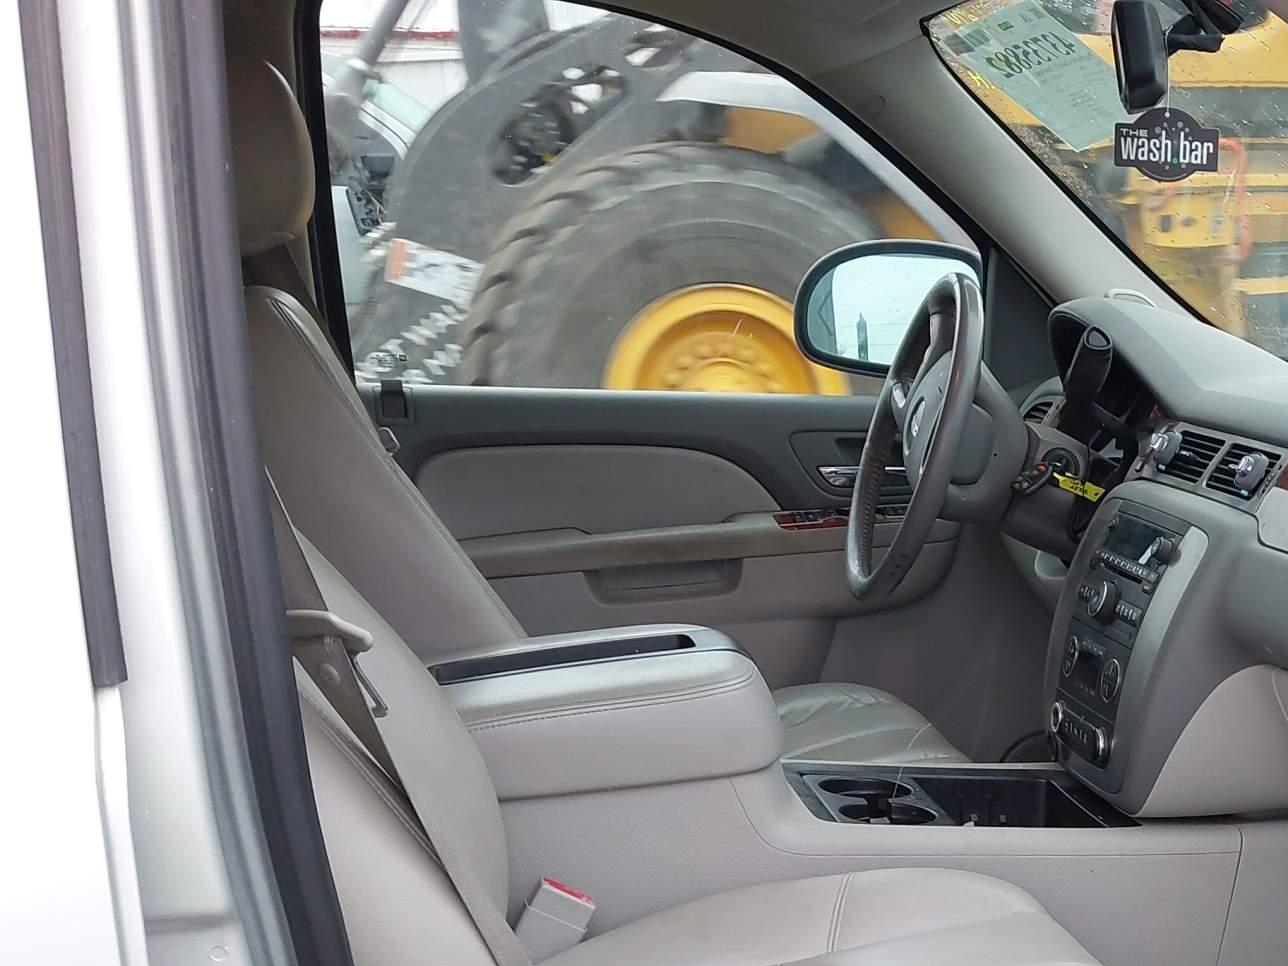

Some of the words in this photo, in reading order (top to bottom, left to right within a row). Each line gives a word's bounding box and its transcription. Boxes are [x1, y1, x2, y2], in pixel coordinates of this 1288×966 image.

[1120, 128, 1148, 137] THE
[1120, 130, 1172, 162] wash
[1180, 131, 1214, 165] bar
